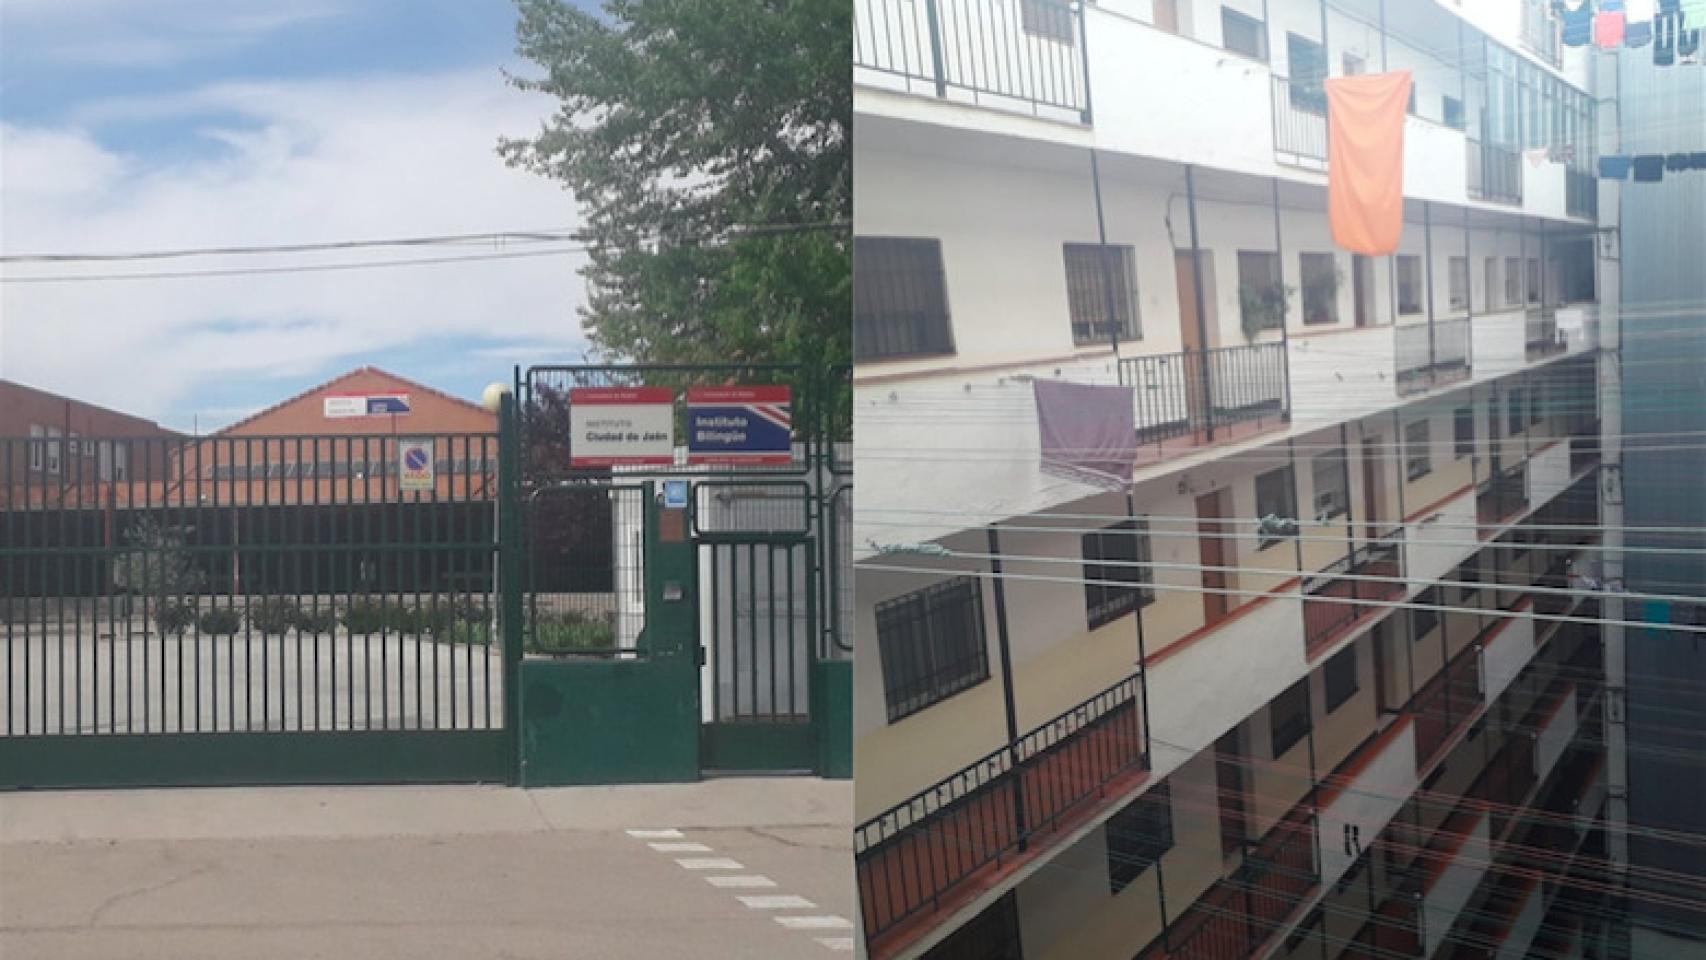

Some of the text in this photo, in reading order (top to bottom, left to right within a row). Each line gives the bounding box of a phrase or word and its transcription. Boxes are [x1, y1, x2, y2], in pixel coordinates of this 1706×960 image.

[697, 416, 748, 427] Instituto
[586, 431, 623, 442] Ciudad
[627, 431, 639, 442] de
[697, 430, 746, 444] Bilingüe
